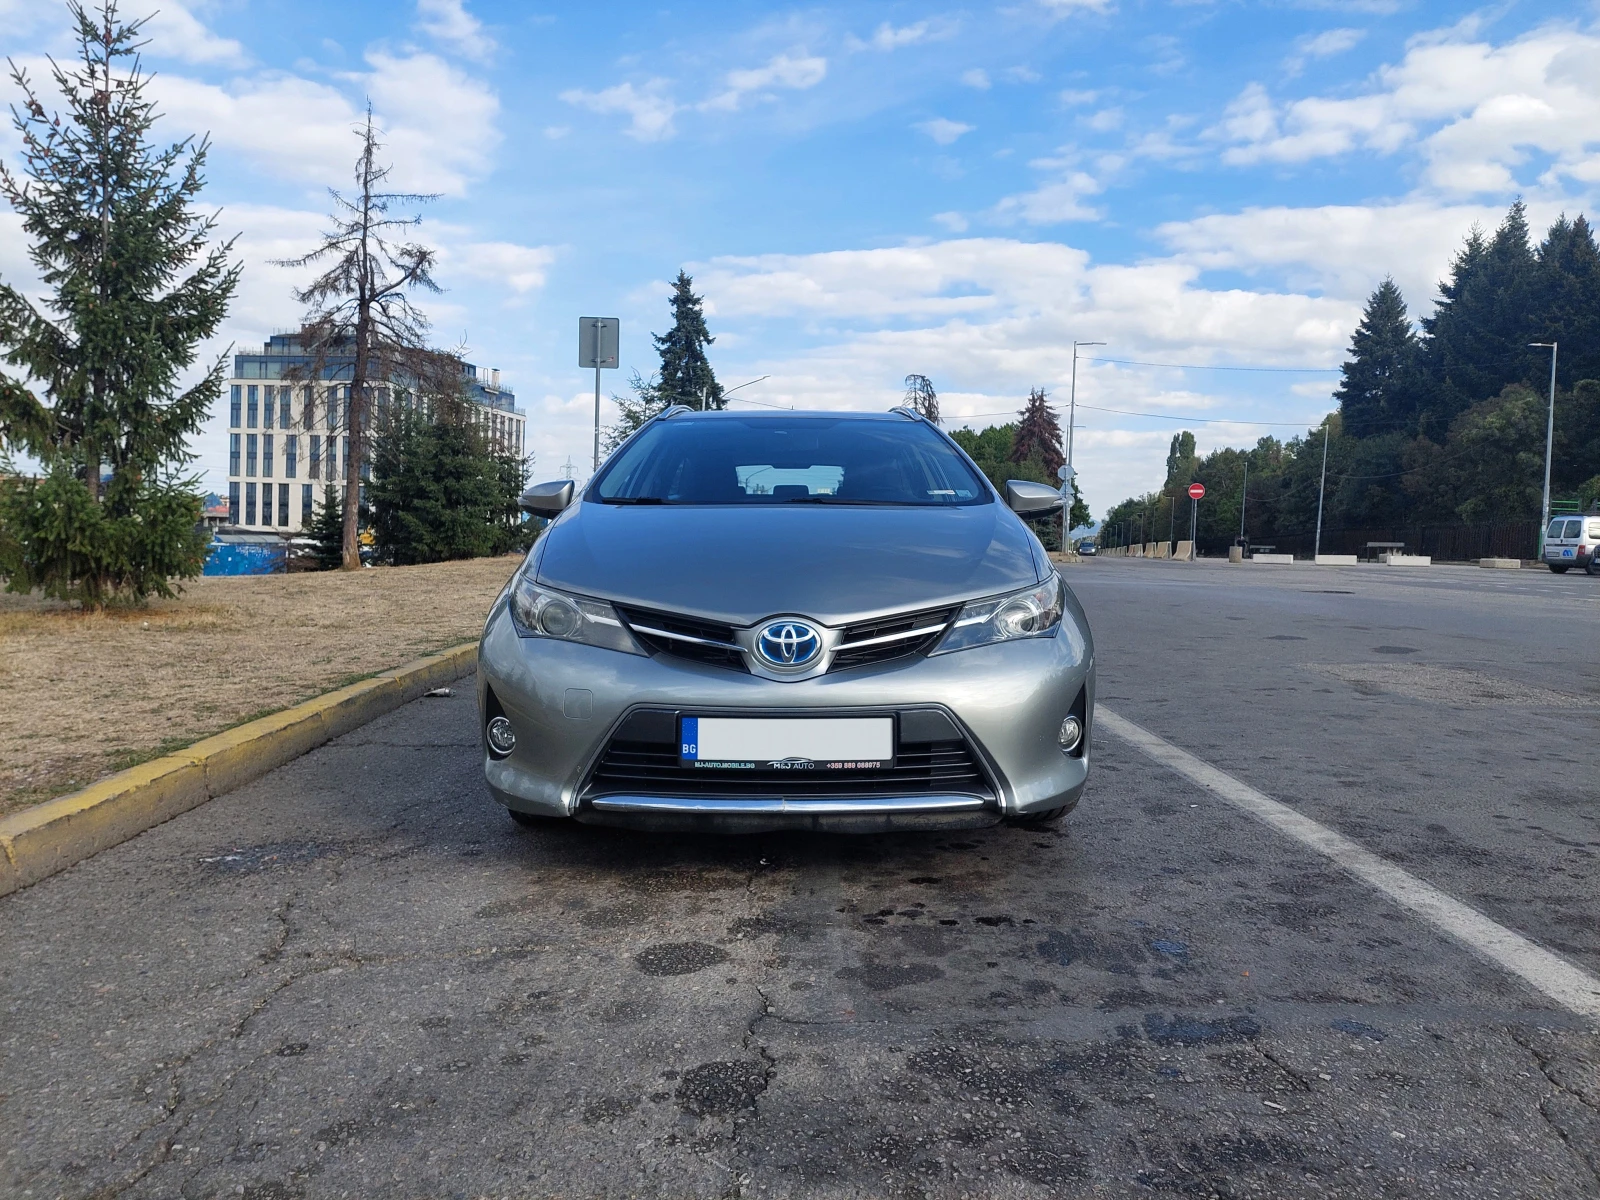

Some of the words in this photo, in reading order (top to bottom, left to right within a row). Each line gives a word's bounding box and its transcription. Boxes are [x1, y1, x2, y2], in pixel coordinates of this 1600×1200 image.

[682, 743, 696, 754] BG
[773, 762, 791, 770] M&J
[792, 762, 815, 770] AUTO
